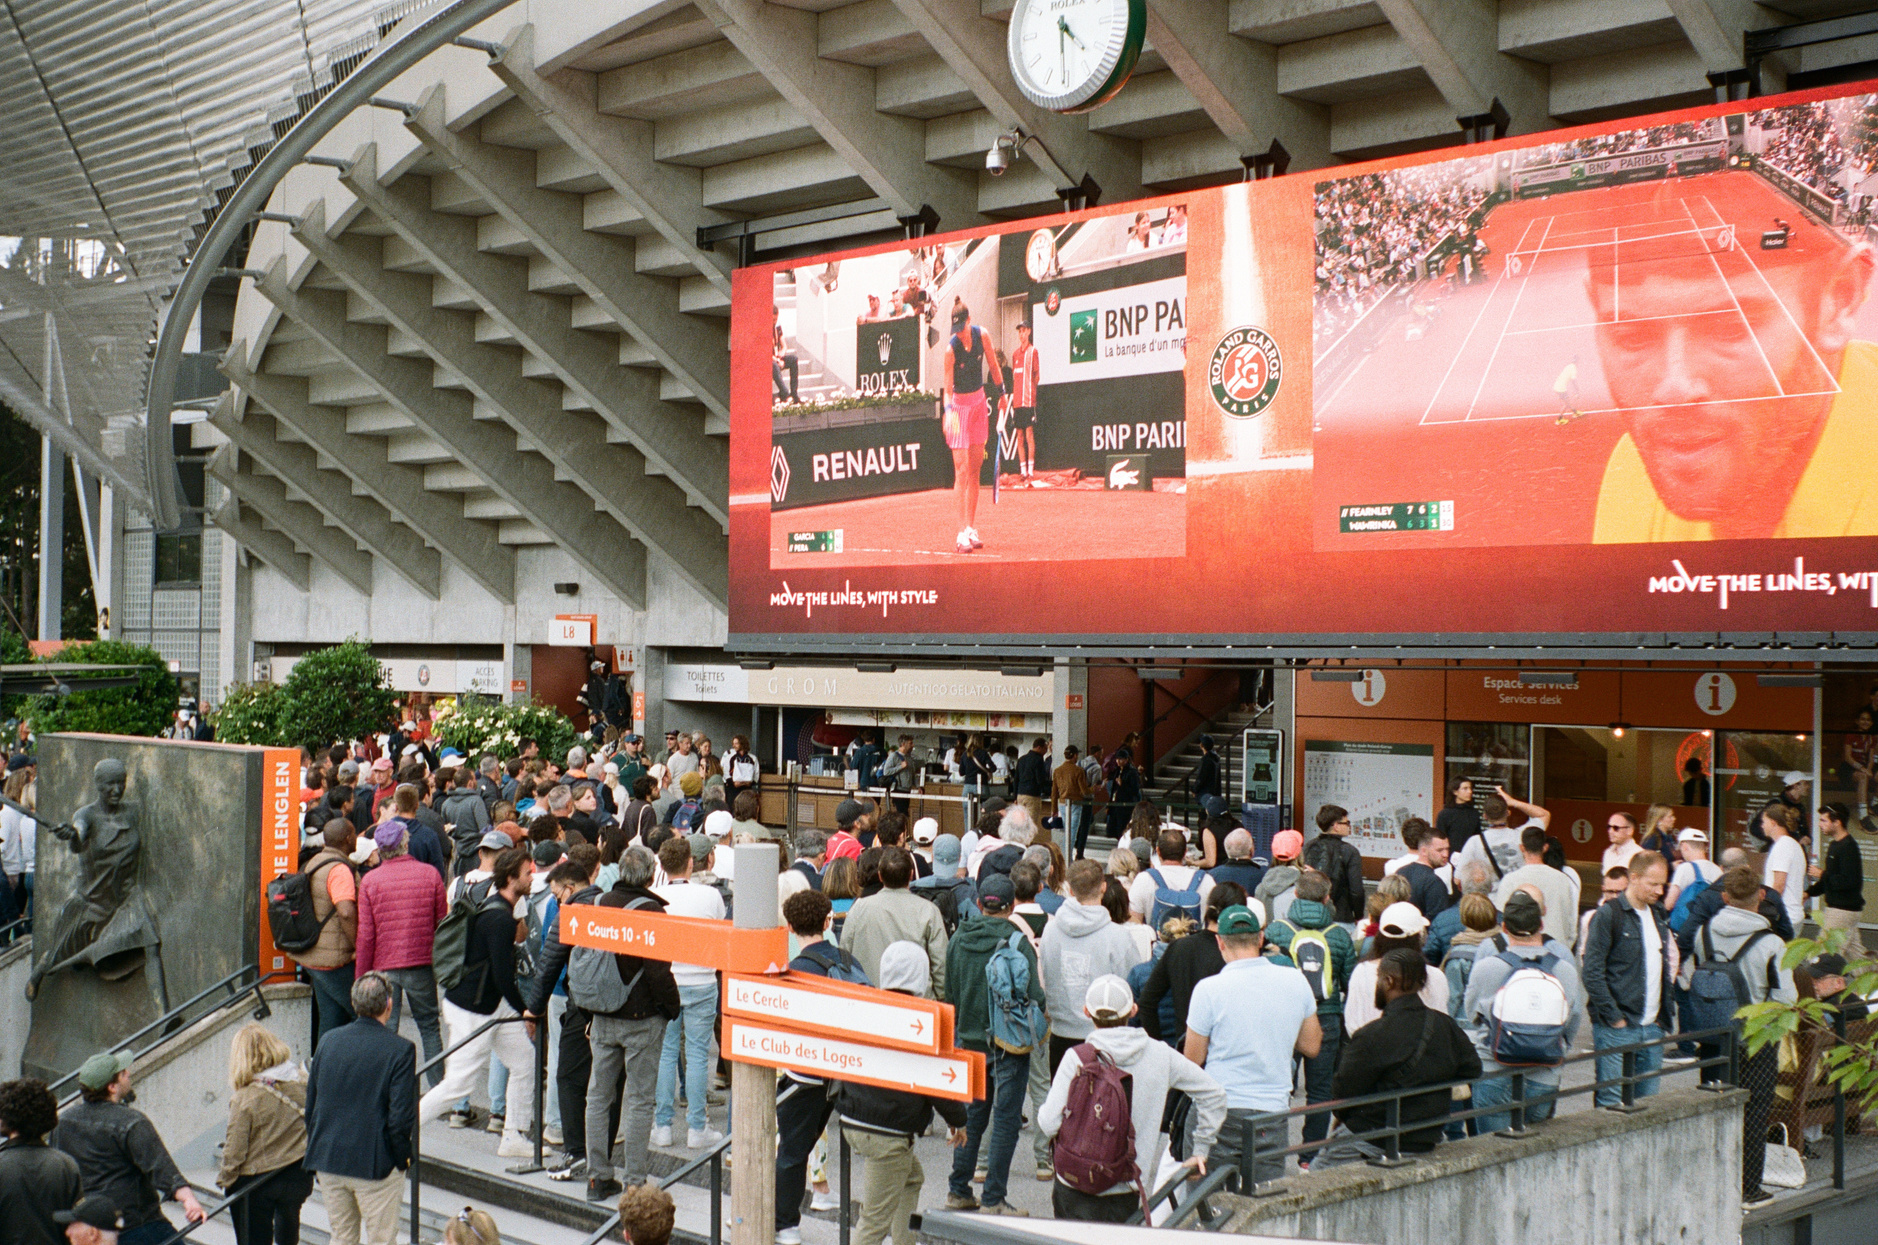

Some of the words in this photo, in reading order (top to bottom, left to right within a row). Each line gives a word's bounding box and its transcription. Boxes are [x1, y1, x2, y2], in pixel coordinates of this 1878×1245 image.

[1588, 161, 1611, 174] BNP
[1619, 152, 1667, 169] PARIBAS
[1105, 304, 1149, 340] BNP
[1104, 346, 1114, 358] La
[1116, 342, 1146, 357] banque
[1149, 338, 1168, 349] d'un
[1211, 332, 1244, 386] ROLAND
[1246, 330, 1280, 380] GARROS
[859, 369, 910, 394] ROLEX
[1221, 392, 1269, 413] PARIS
[1092, 424, 1131, 450] BNP
[812, 443, 921, 483] RENAULT
[1349, 506, 1394, 517] FEARNLEY
[1407, 505, 1414, 514] 7
[1419, 505, 1426, 514] 6
[1431, 504, 1438, 514] 2
[1349, 520, 1397, 530] WAWRINKA
[1407, 520, 1413, 528] 6
[1420, 520, 1425, 528] 3
[1431, 519, 1438, 528] 1
[1649, 559, 1716, 593] MOVE
[1716, 574, 1762, 609] THE
[1765, 556, 1837, 595] LINES,
[770, 581, 804, 606] MOVE
[804, 591, 828, 618] THE
[830, 579, 867, 608] LINES,
[867, 591, 899, 617] WITH
[900, 590, 939, 604] STYLE
[563, 625, 575, 639] L8
[687, 671, 725, 682] TOILETTES
[768, 677, 838, 697] GROM
[1483, 676, 1524, 691] Espace
[695, 683, 718, 694] Toilets
[888, 683, 948, 696] AUTENTICO
[950, 685, 991, 697] GELATO
[992, 685, 1044, 698] ITALIANO
[1499, 694, 1538, 704] Services
[1540, 695, 1562, 704] desk
[274, 762, 290, 851] LENGLEN
[587, 921, 619, 941] Courts
[621, 926, 634, 943] 10
[643, 930, 656, 947] 16
[736, 988, 749, 1002] Le
[753, 991, 790, 1011] Cercle
[742, 1034, 757, 1050] Le
[761, 1037, 791, 1056] Club
[795, 1045, 818, 1061] des
[823, 1047, 863, 1070] Loges
